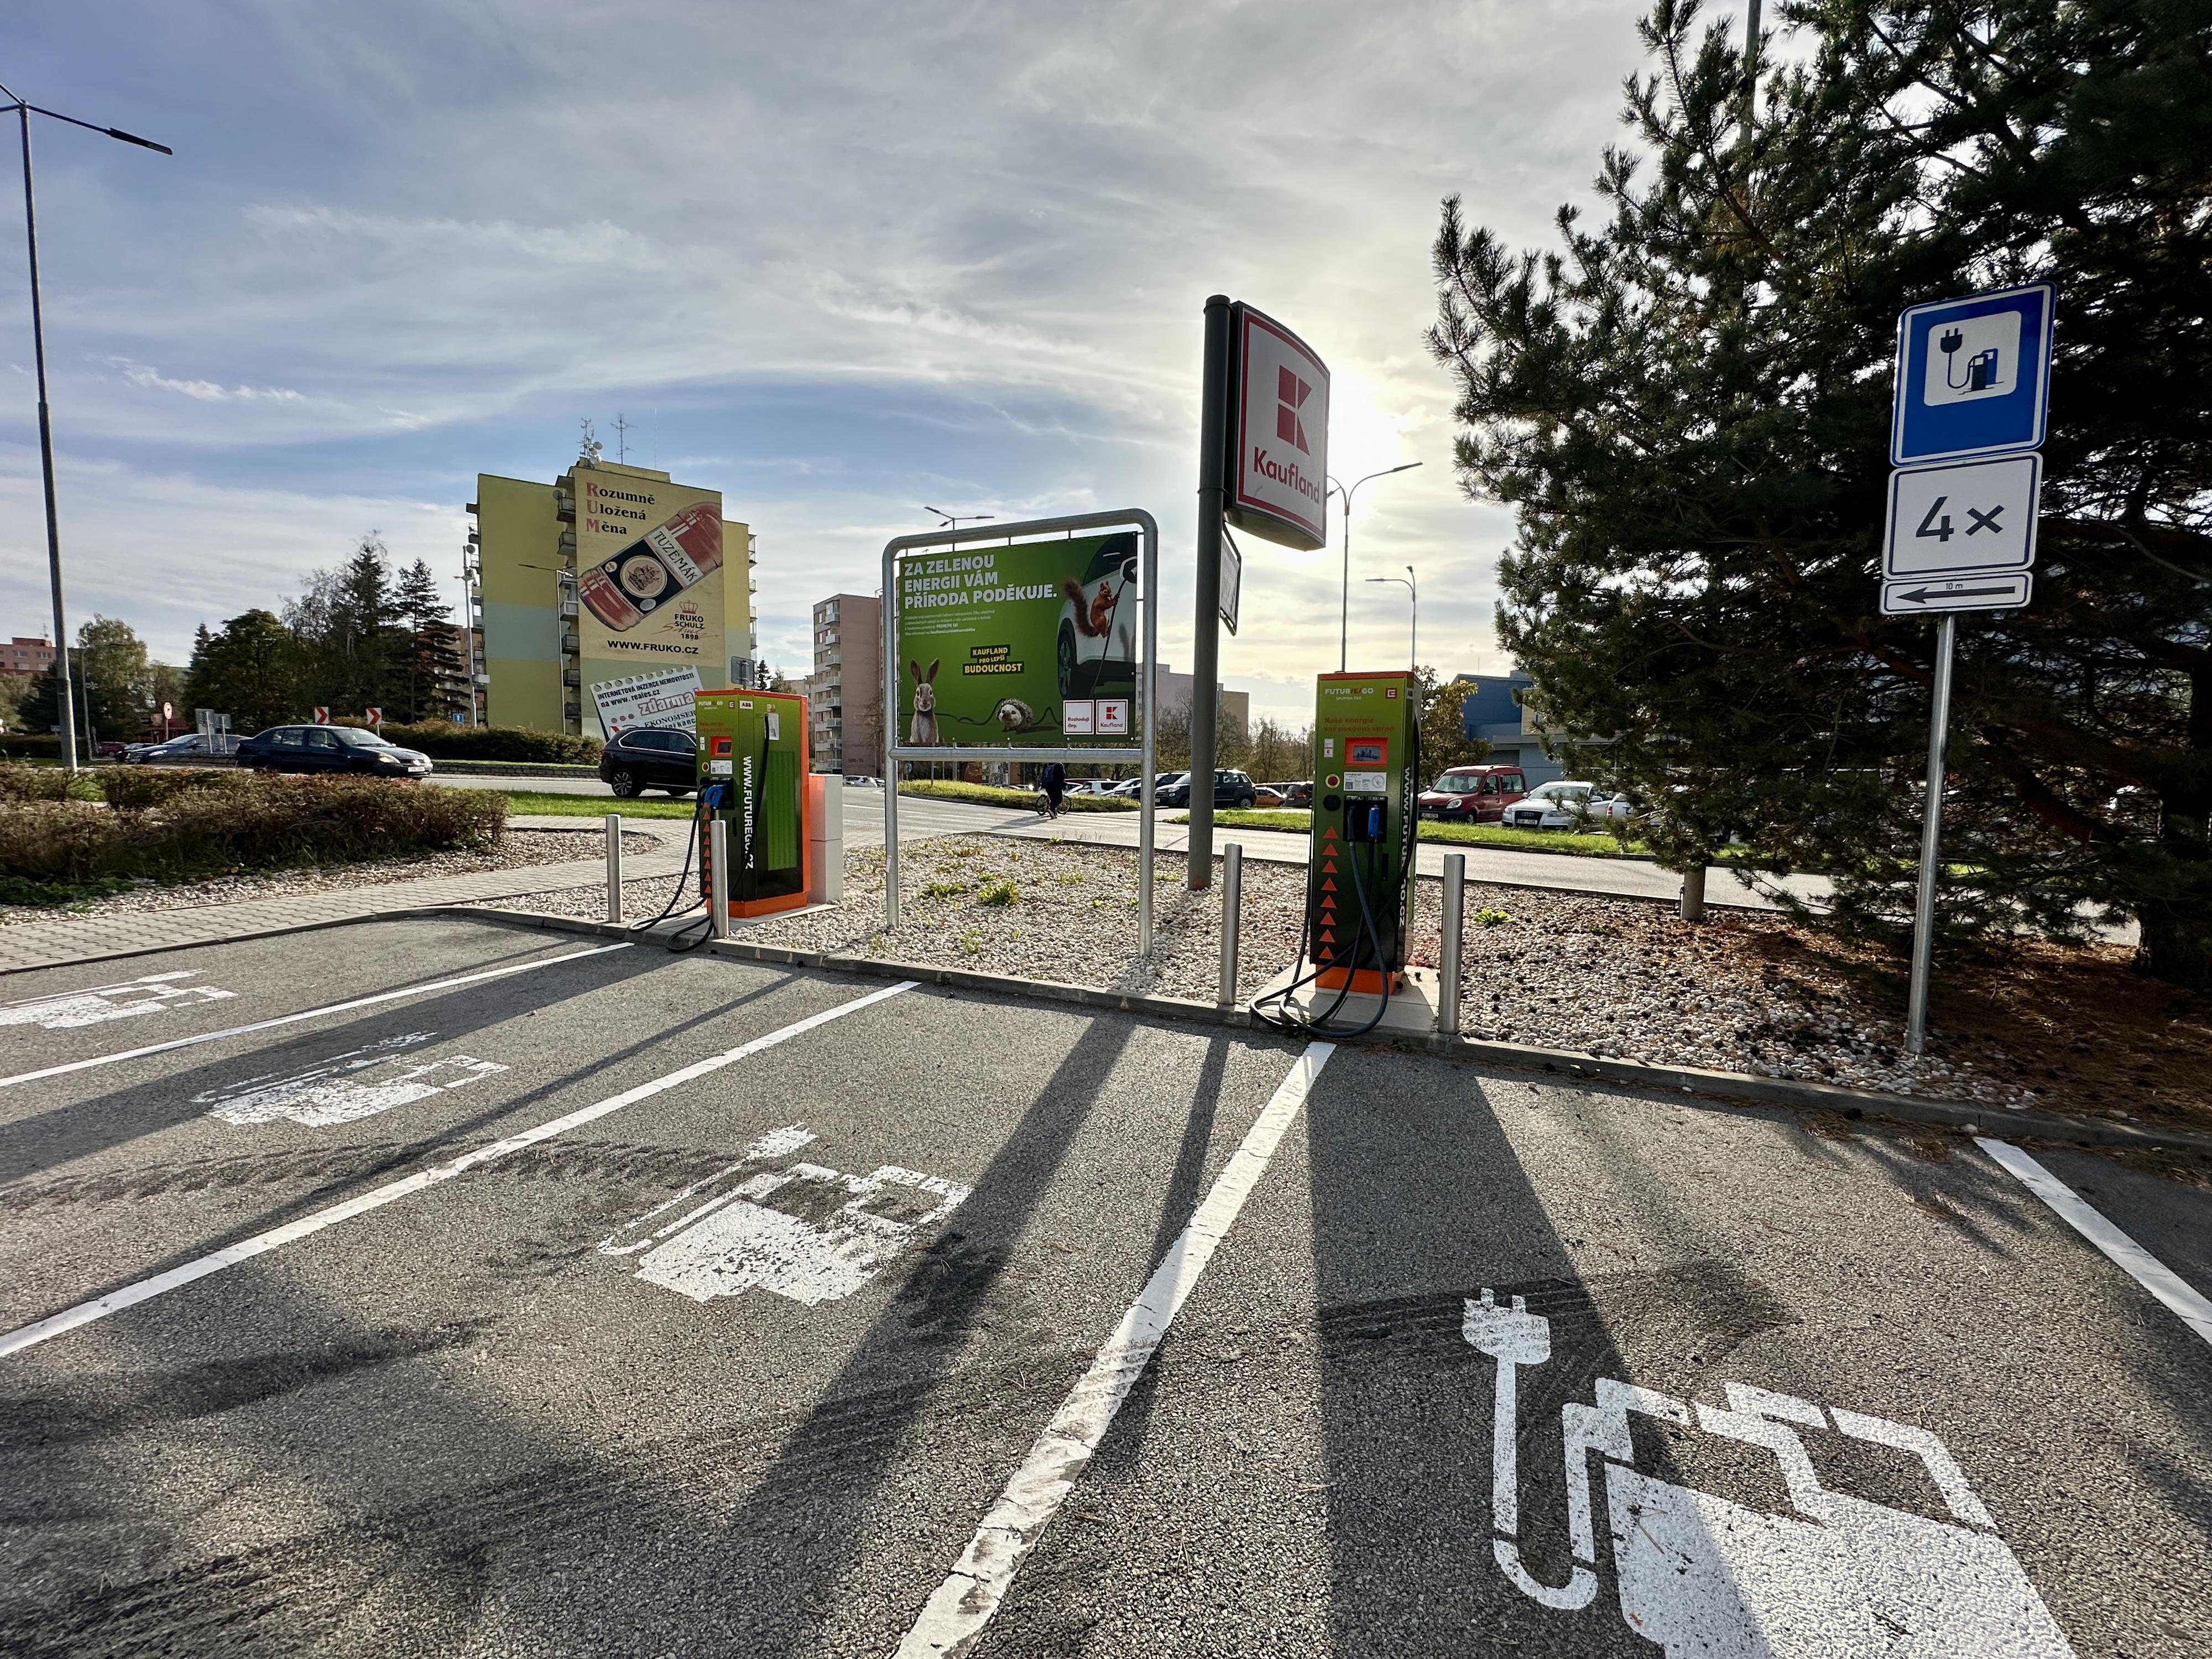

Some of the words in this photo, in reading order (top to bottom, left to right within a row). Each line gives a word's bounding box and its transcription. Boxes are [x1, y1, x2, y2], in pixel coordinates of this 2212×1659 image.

[1254, 446, 1319, 505] Kaufland
[586, 482, 655, 505] Rozumně
[586, 499, 646, 520] Uložená
[586, 518, 627, 535] Měna
[654, 531, 697, 582] TUZEMÁK
[905, 562, 924, 576] ZA
[926, 555, 994, 574] ZELENOU
[905, 576, 960, 592] ENERGII
[964, 569, 998, 587] VÁM
[905, 591, 969, 609] PŘÍRODA
[973, 583, 1057, 604] PODĚKUJE.
[675, 614, 704, 622] FRUKO
[675, 621, 704, 629] SCHULZ
[607, 640, 699, 654] WWW.FRUKO.CZ
[973, 647, 1008, 656] KAUFLAND
[964, 663, 1022, 674] BUDOUCNOST
[597, 685, 636, 700] INTERNETOVÁ
[637, 680, 660, 691] INZERCE
[638, 687, 699, 716] zdarma
